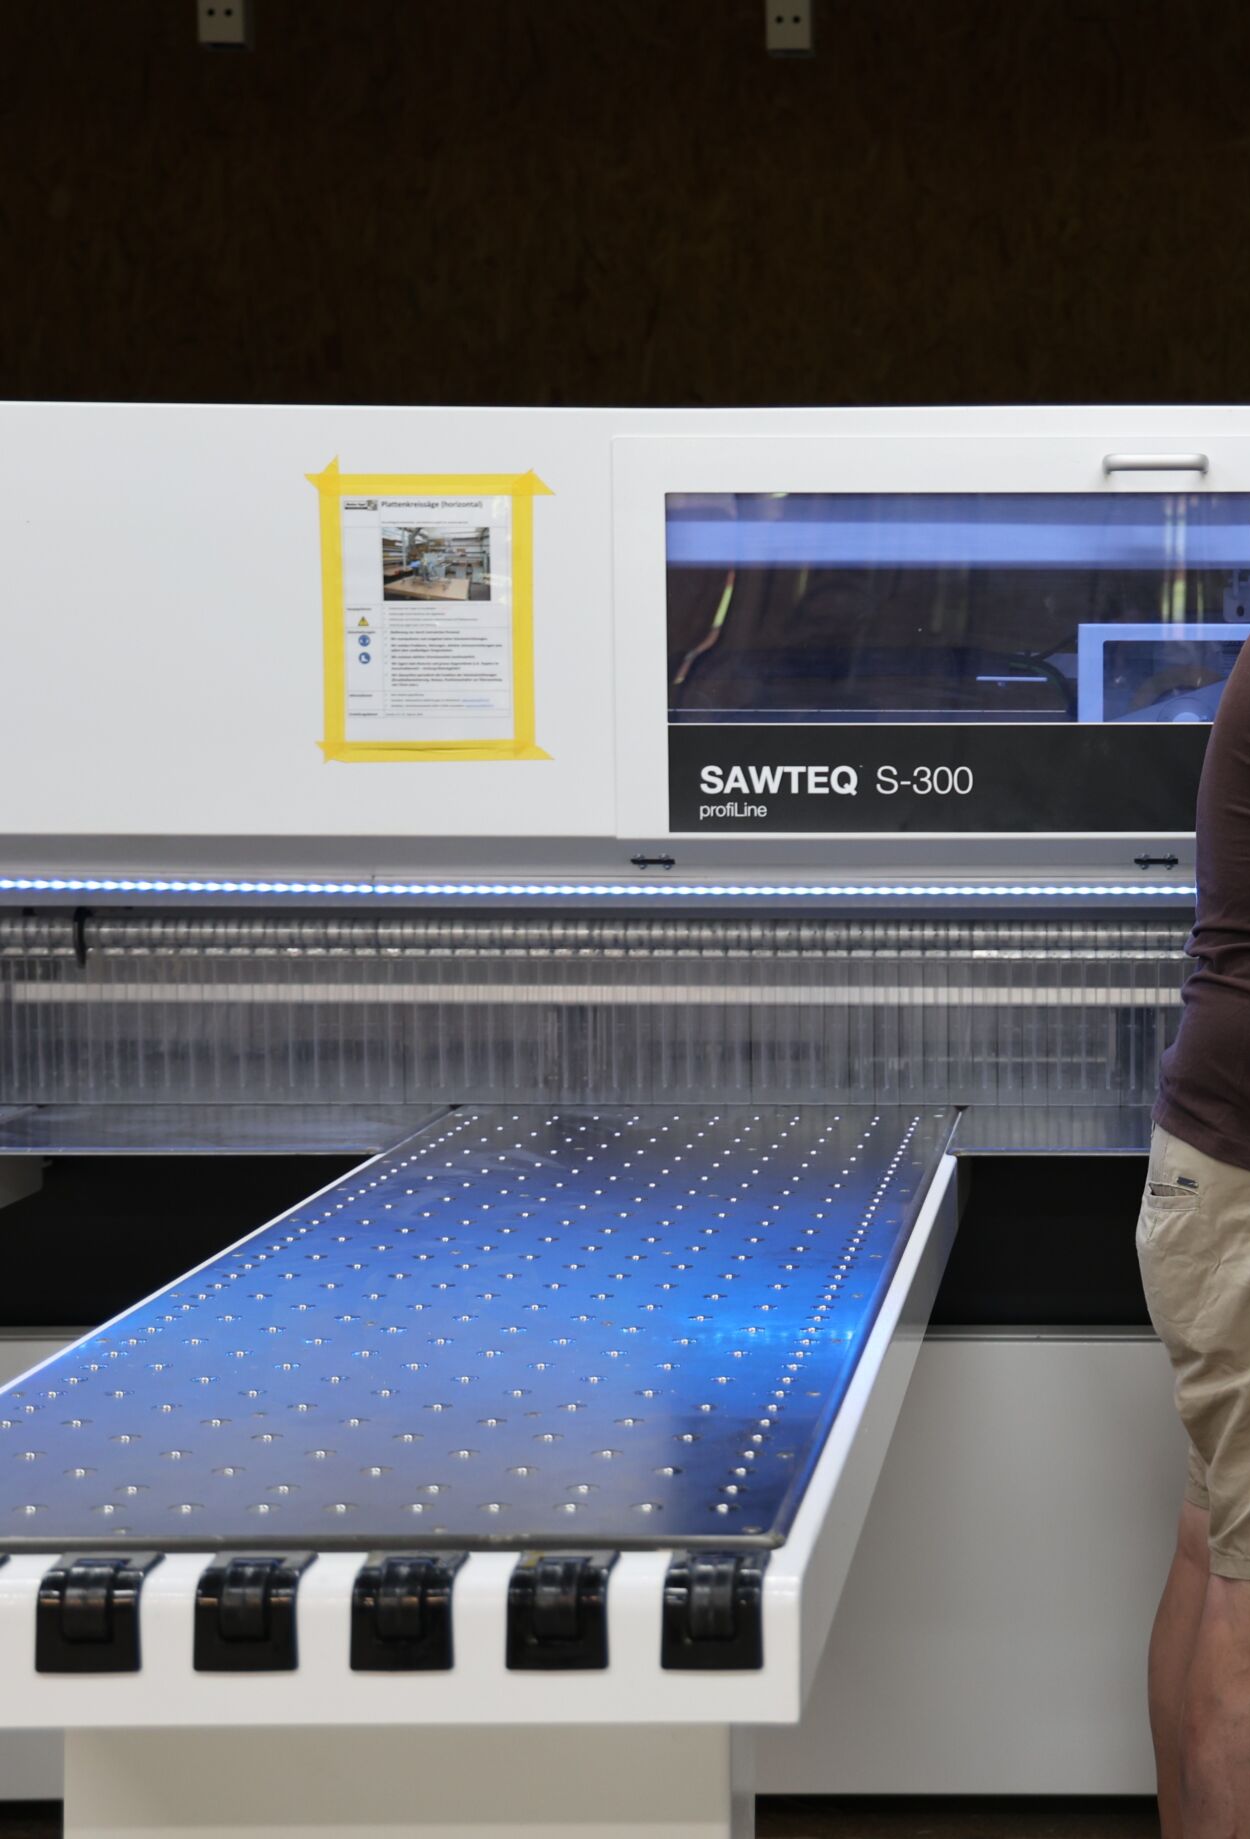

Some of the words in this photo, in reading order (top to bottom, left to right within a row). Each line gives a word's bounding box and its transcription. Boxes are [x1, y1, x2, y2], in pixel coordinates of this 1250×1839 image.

[700, 765, 858, 796] SAWTEQ
[875, 765, 974, 795] S-300
[699, 802, 768, 820] profiLine
